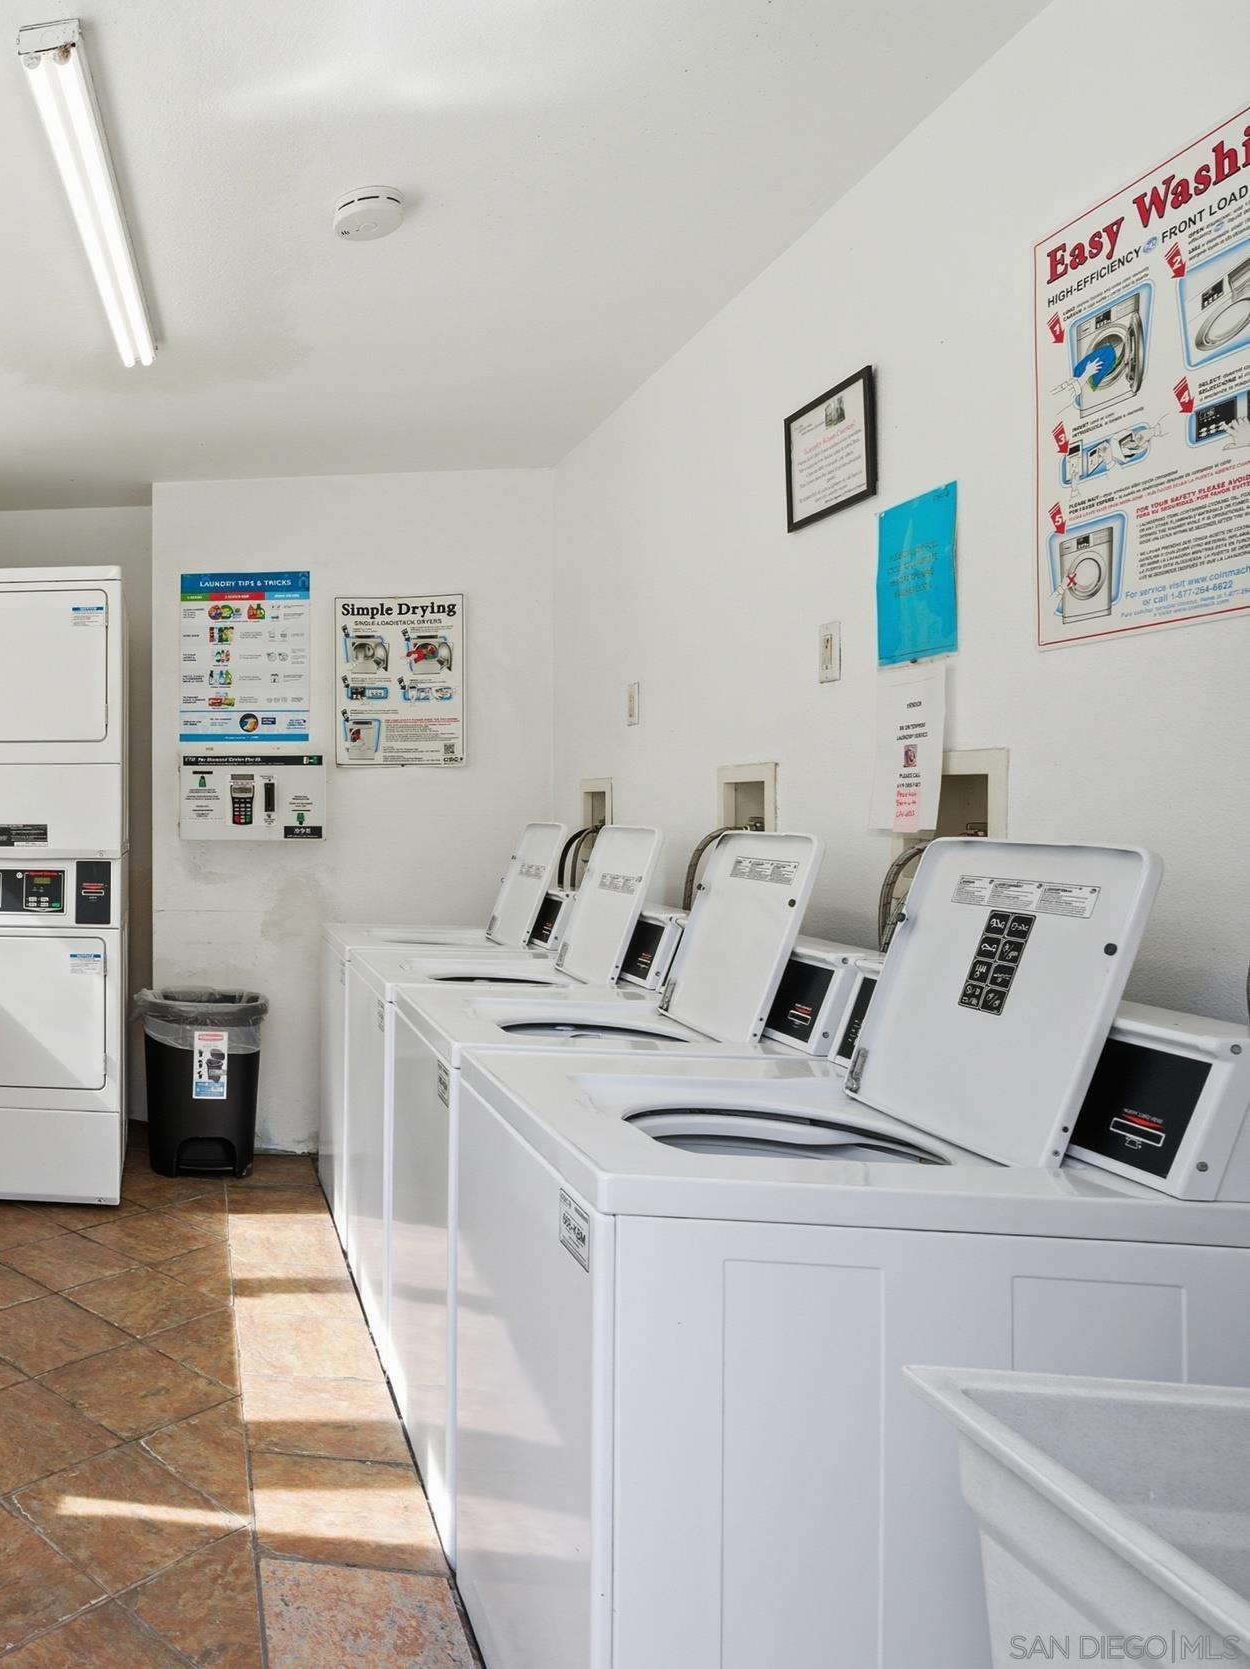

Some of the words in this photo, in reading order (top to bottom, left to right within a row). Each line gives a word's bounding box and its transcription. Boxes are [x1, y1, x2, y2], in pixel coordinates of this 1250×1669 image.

[1047, 246, 1142, 308] HIGH-EFFICIENCY
[1161, 208, 1206, 244] FRONT
[1209, 185, 1249, 217] LOAD
[1047, 217, 1125, 285] Easy
[1173, 256, 1182, 270] 2
[1180, 390, 1191, 403] 4
[1057, 434, 1066, 445] 3
[1136, 504, 1149, 514] FOR
[1150, 498, 1169, 510] YOUR
[1170, 489, 1196, 504] SAFETY
[1198, 480, 1226, 495] PLEASE
[1227, 472, 1250, 486] AVOID
[1054, 515, 1062, 526] 5
[1125, 591, 1138, 600] For
[1139, 585, 1167, 597] service
[1169, 580, 1185, 590] visit
[1153, 594, 1168, 605] call
[341, 602, 394, 620] Simple
[397, 601, 457, 618] Drying
